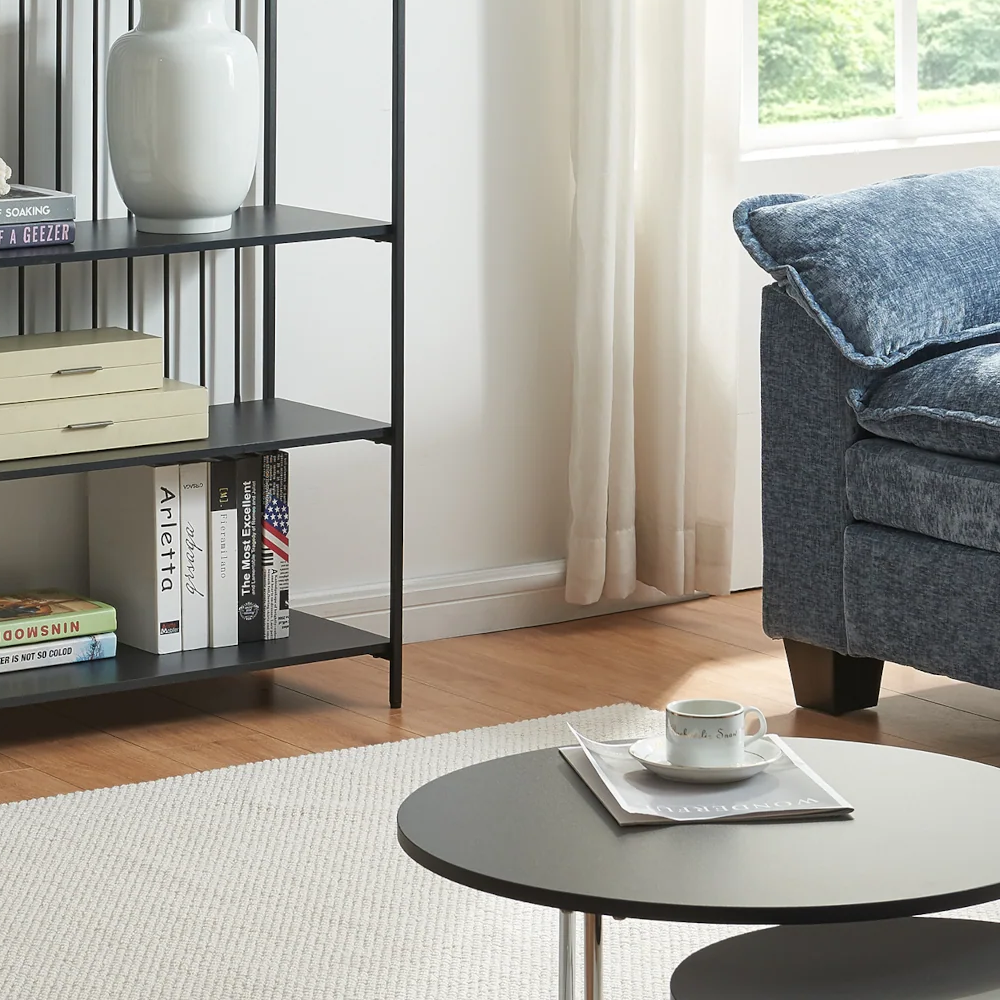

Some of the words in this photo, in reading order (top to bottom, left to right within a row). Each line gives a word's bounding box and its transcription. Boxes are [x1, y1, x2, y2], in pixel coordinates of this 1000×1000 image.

[5, 205, 51, 218] SOAKING
[9, 228, 17, 245] A
[23, 223, 70, 244] GEEZER
[242, 480, 251, 537] Excellent
[160, 486, 178, 592] Arletta
[241, 541, 251, 570] Most
[241, 573, 251, 596] The
[11, 653, 19, 663] IS
[20, 652, 36, 662] NOT
[37, 649, 47, 660] SO
[49, 647, 73, 659] COLOD
